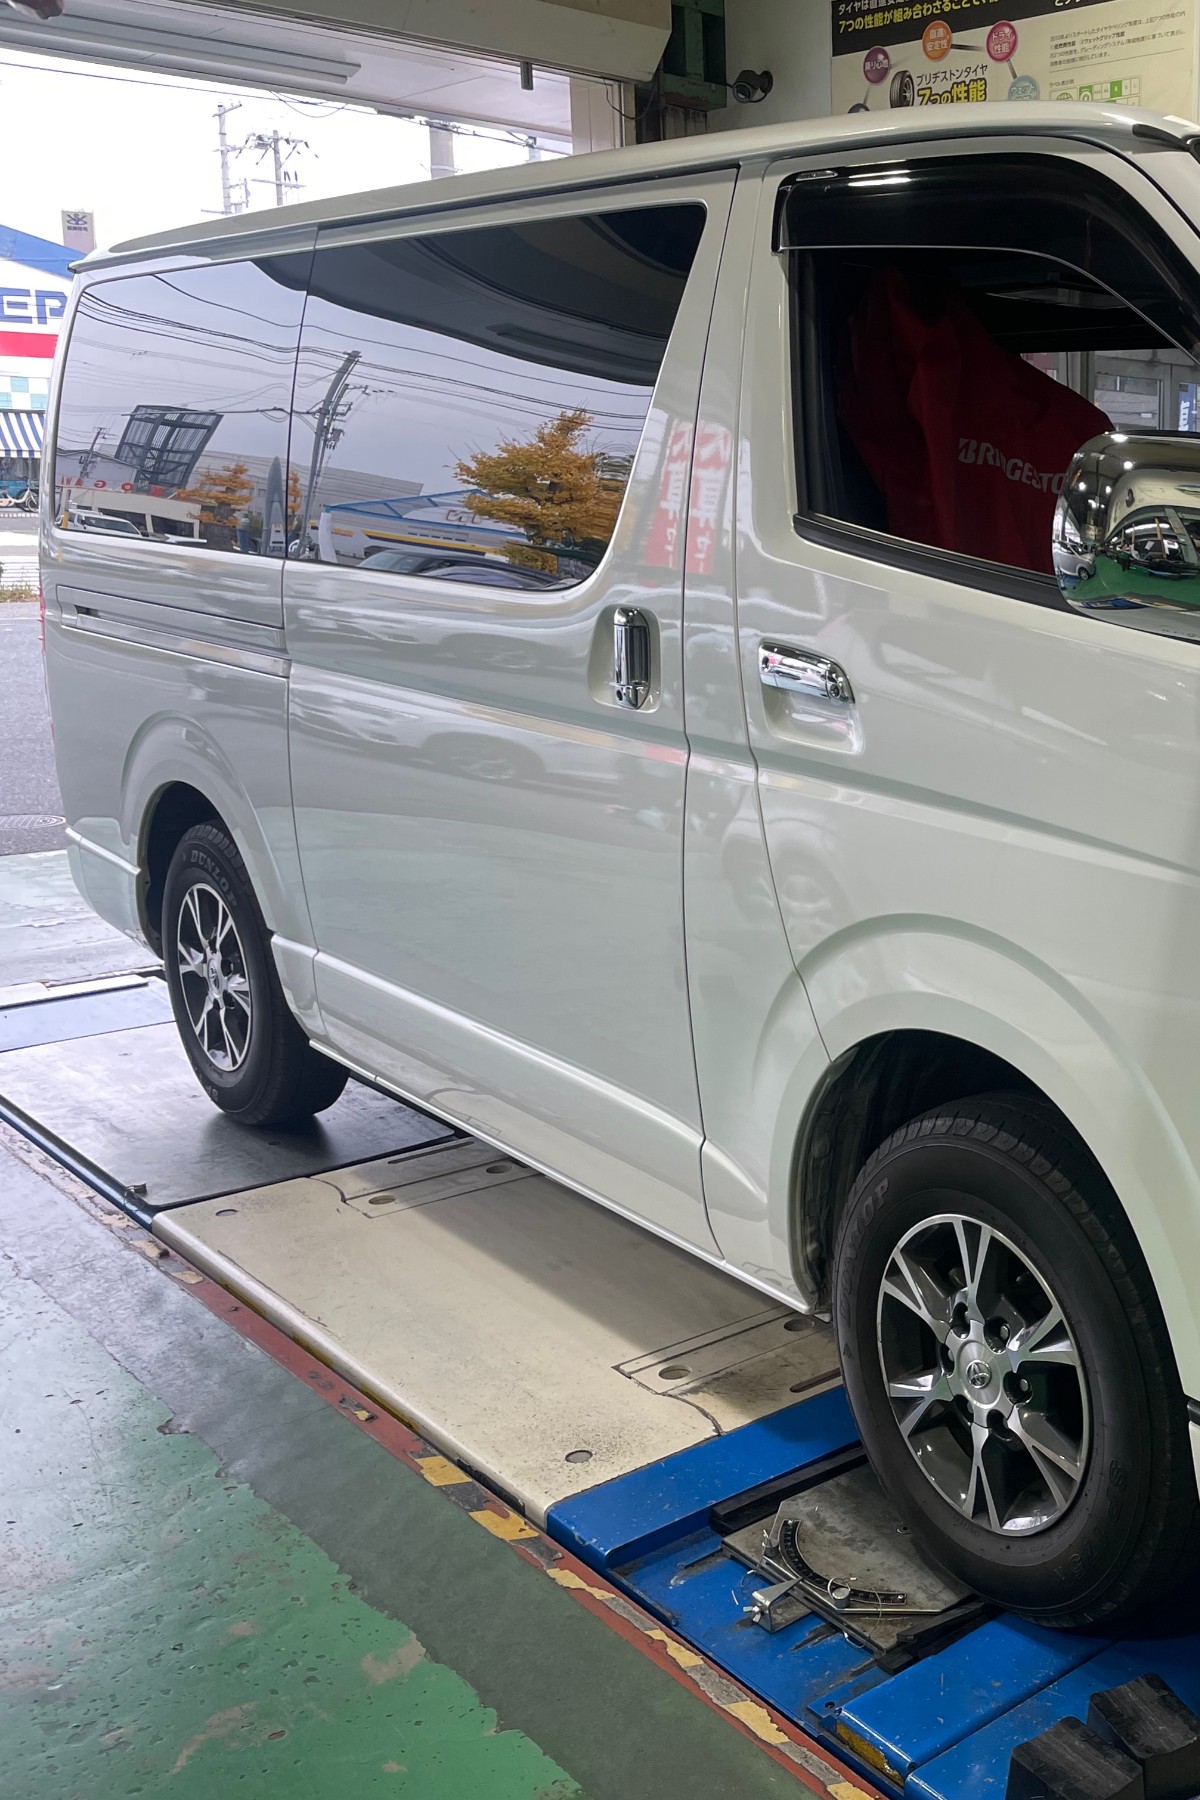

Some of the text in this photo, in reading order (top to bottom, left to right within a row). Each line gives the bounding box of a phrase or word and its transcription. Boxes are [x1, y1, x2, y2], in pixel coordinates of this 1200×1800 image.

[993, 43, 1010, 55] 性能
[916, 64, 988, 87] ブリヂストンタイヤ
[917, 77, 987, 107] 7つの性能
[190, 849, 237, 906] DUNLOP
